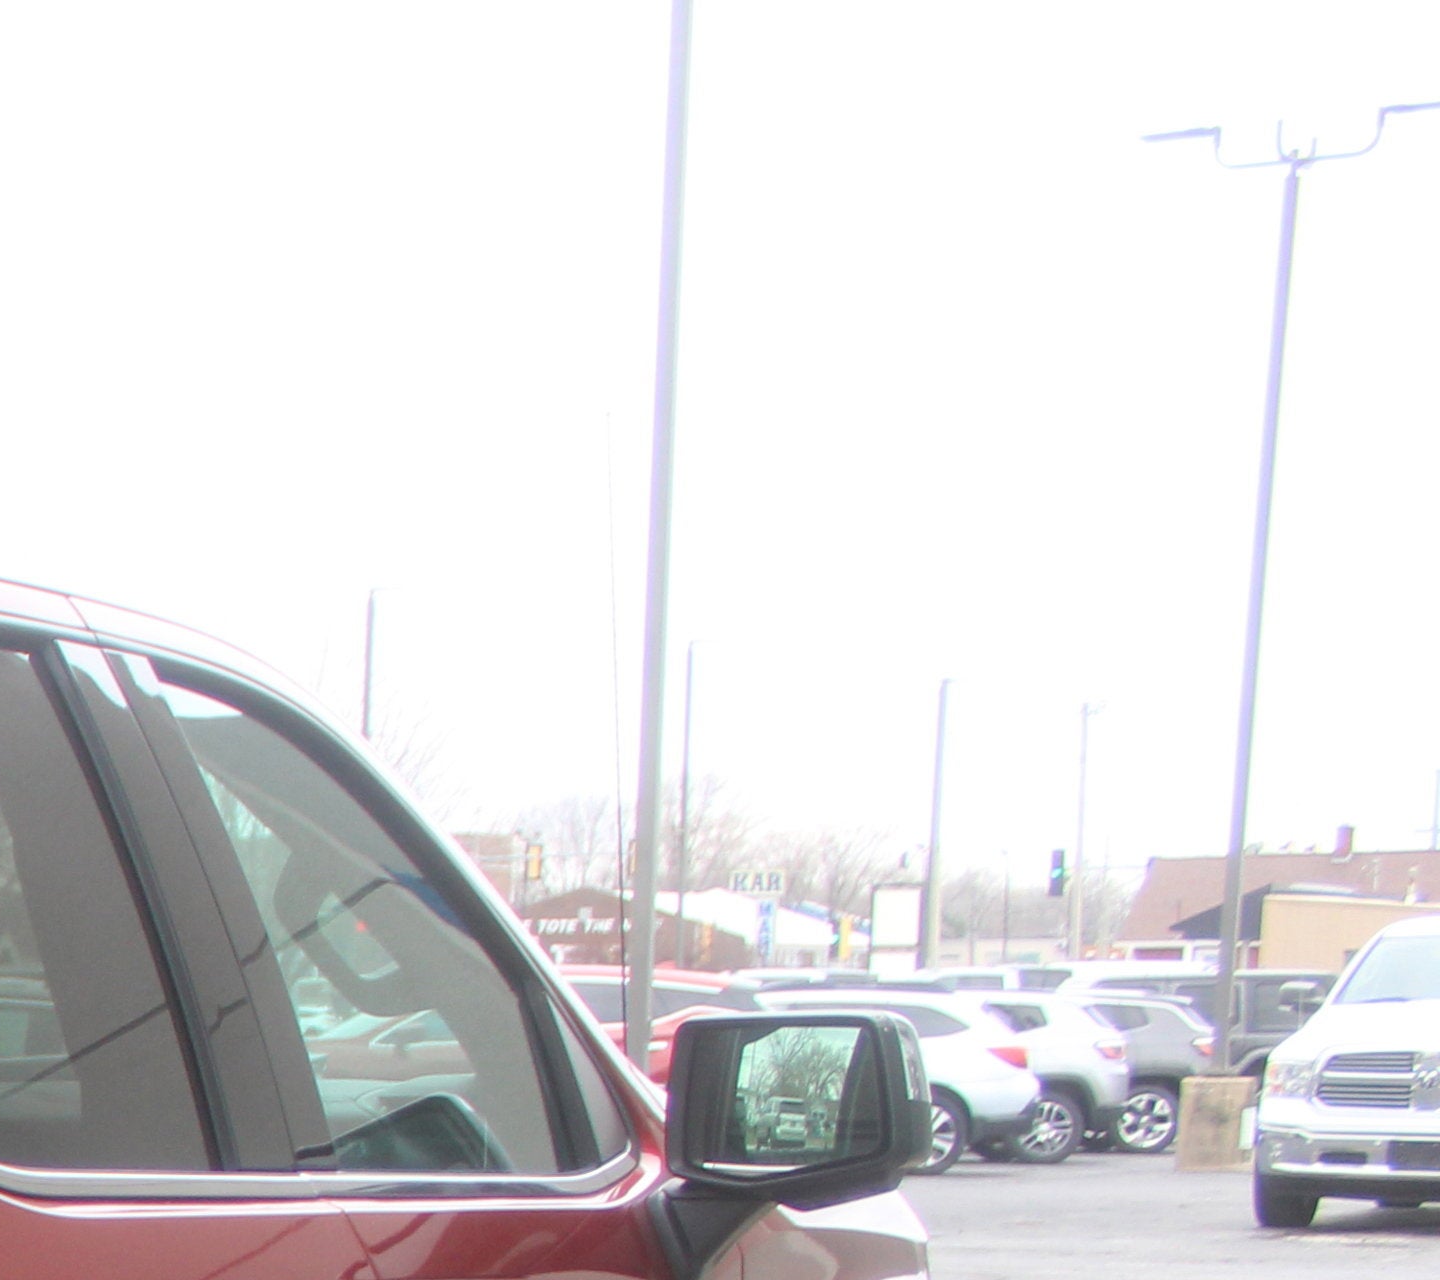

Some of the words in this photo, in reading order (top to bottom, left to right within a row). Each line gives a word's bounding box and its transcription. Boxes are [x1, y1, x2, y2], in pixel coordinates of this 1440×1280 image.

[733, 870, 782, 892] KAR
[537, 918, 578, 934] TOTE
[582, 917, 616, 934] THE
